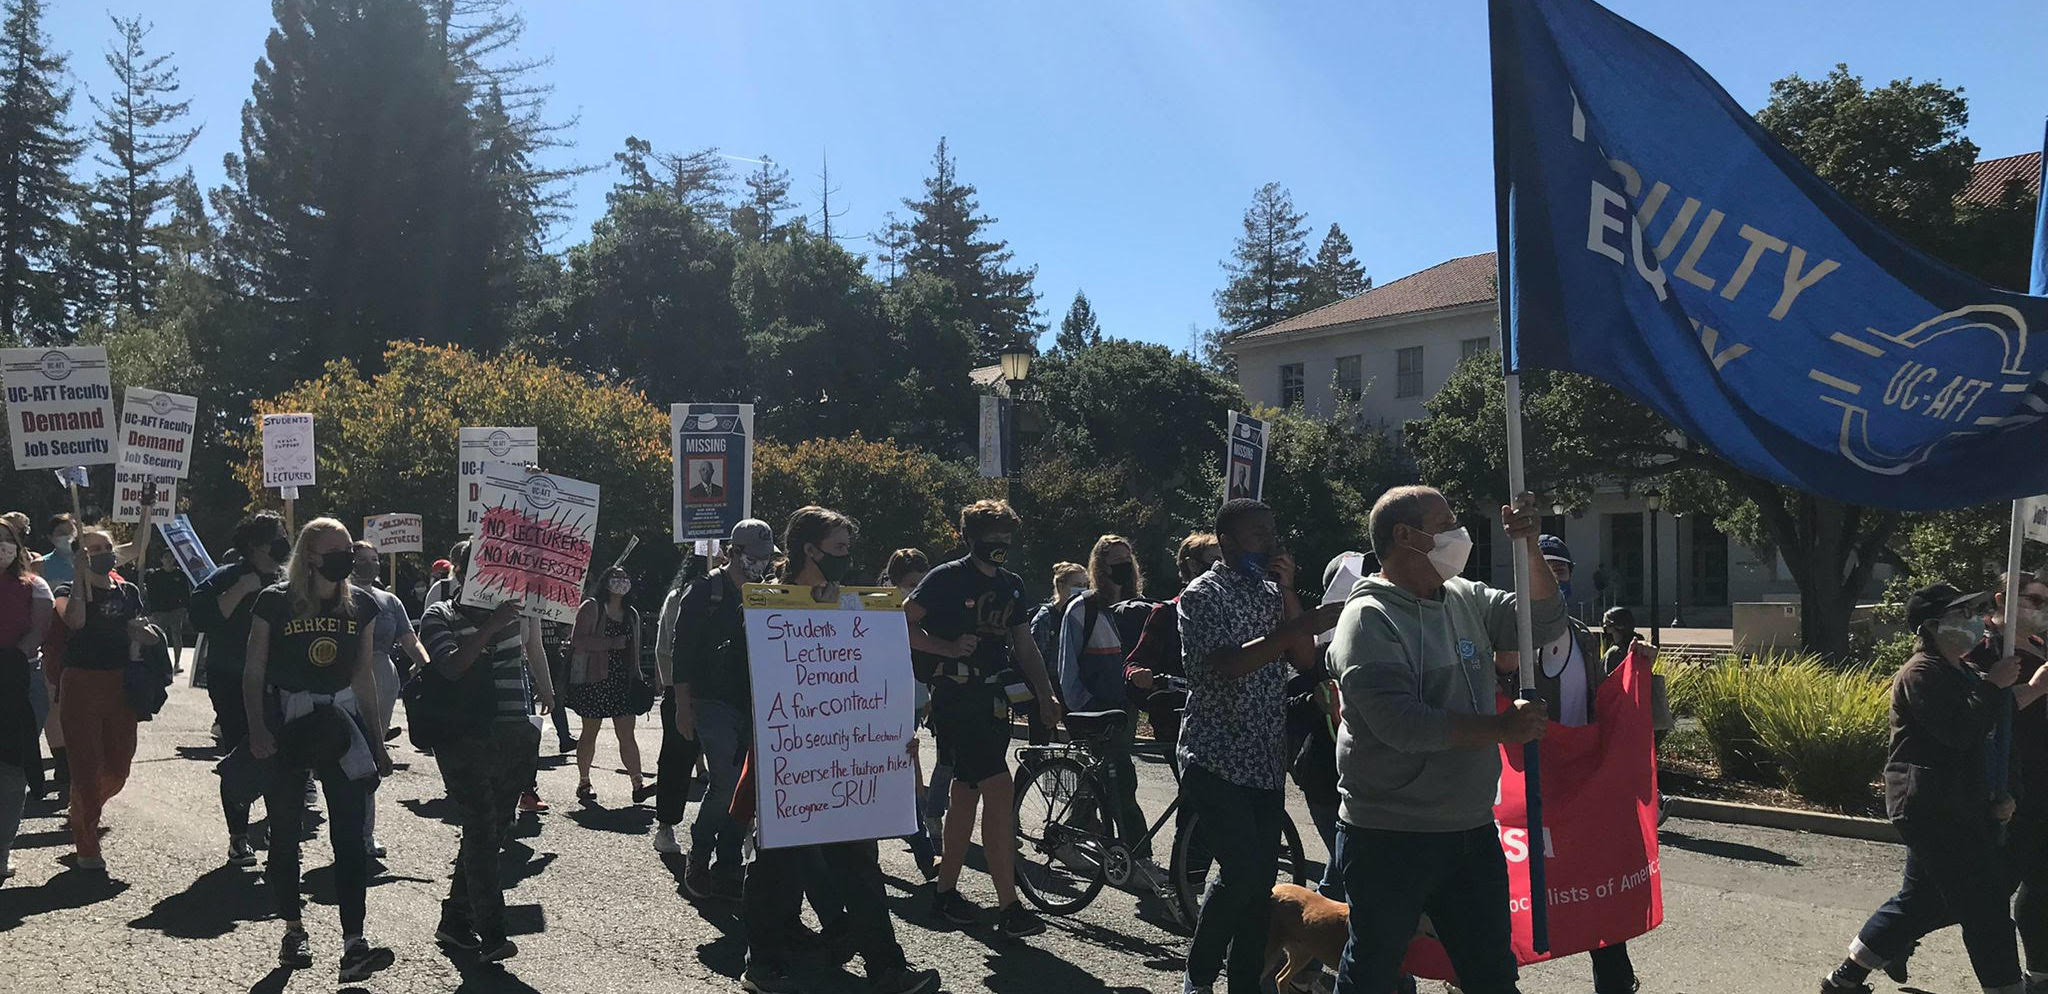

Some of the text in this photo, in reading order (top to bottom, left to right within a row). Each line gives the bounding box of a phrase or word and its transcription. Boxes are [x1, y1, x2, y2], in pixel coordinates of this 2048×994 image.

[1586, 180, 1752, 371] EQY
[8, 383, 109, 402] UC-AFT Faculty
[1883, 360, 1993, 422] UC-AFT
[21, 408, 104, 433] Demand
[124, 412, 193, 435] UC-AFT Faculty
[264, 416, 309, 426] STUDENTS
[24, 437, 108, 457] Job Security
[128, 430, 185, 453] Demand
[686, 438, 727, 453] MISSING
[1233, 442, 1254, 460] MISSING
[125, 451, 183, 471] Job Security
[117, 472, 175, 486] UC-AFT Fculty
[266, 472, 312, 483] LECTURERS
[122, 487, 169, 502] Dend
[120, 505, 134, 516] Job
[468, 509, 478, 523] Jo
[487, 518, 506, 537] NO
[484, 546, 503, 563] NO
[977, 591, 1016, 630] Cal
[766, 614, 870, 640] Students &
[784, 640, 862, 663] Lecturers
[796, 663, 860, 686] Demand
[768, 679, 888, 721] A fair contract!
[768, 724, 803, 752] Job
[805, 729, 850, 751] security
[852, 726, 868, 743] for
[774, 755, 912, 786] Reverse the tuition hike!
[775, 775, 878, 823] Recognize SRU!
[1596, 878, 1615, 898] of
